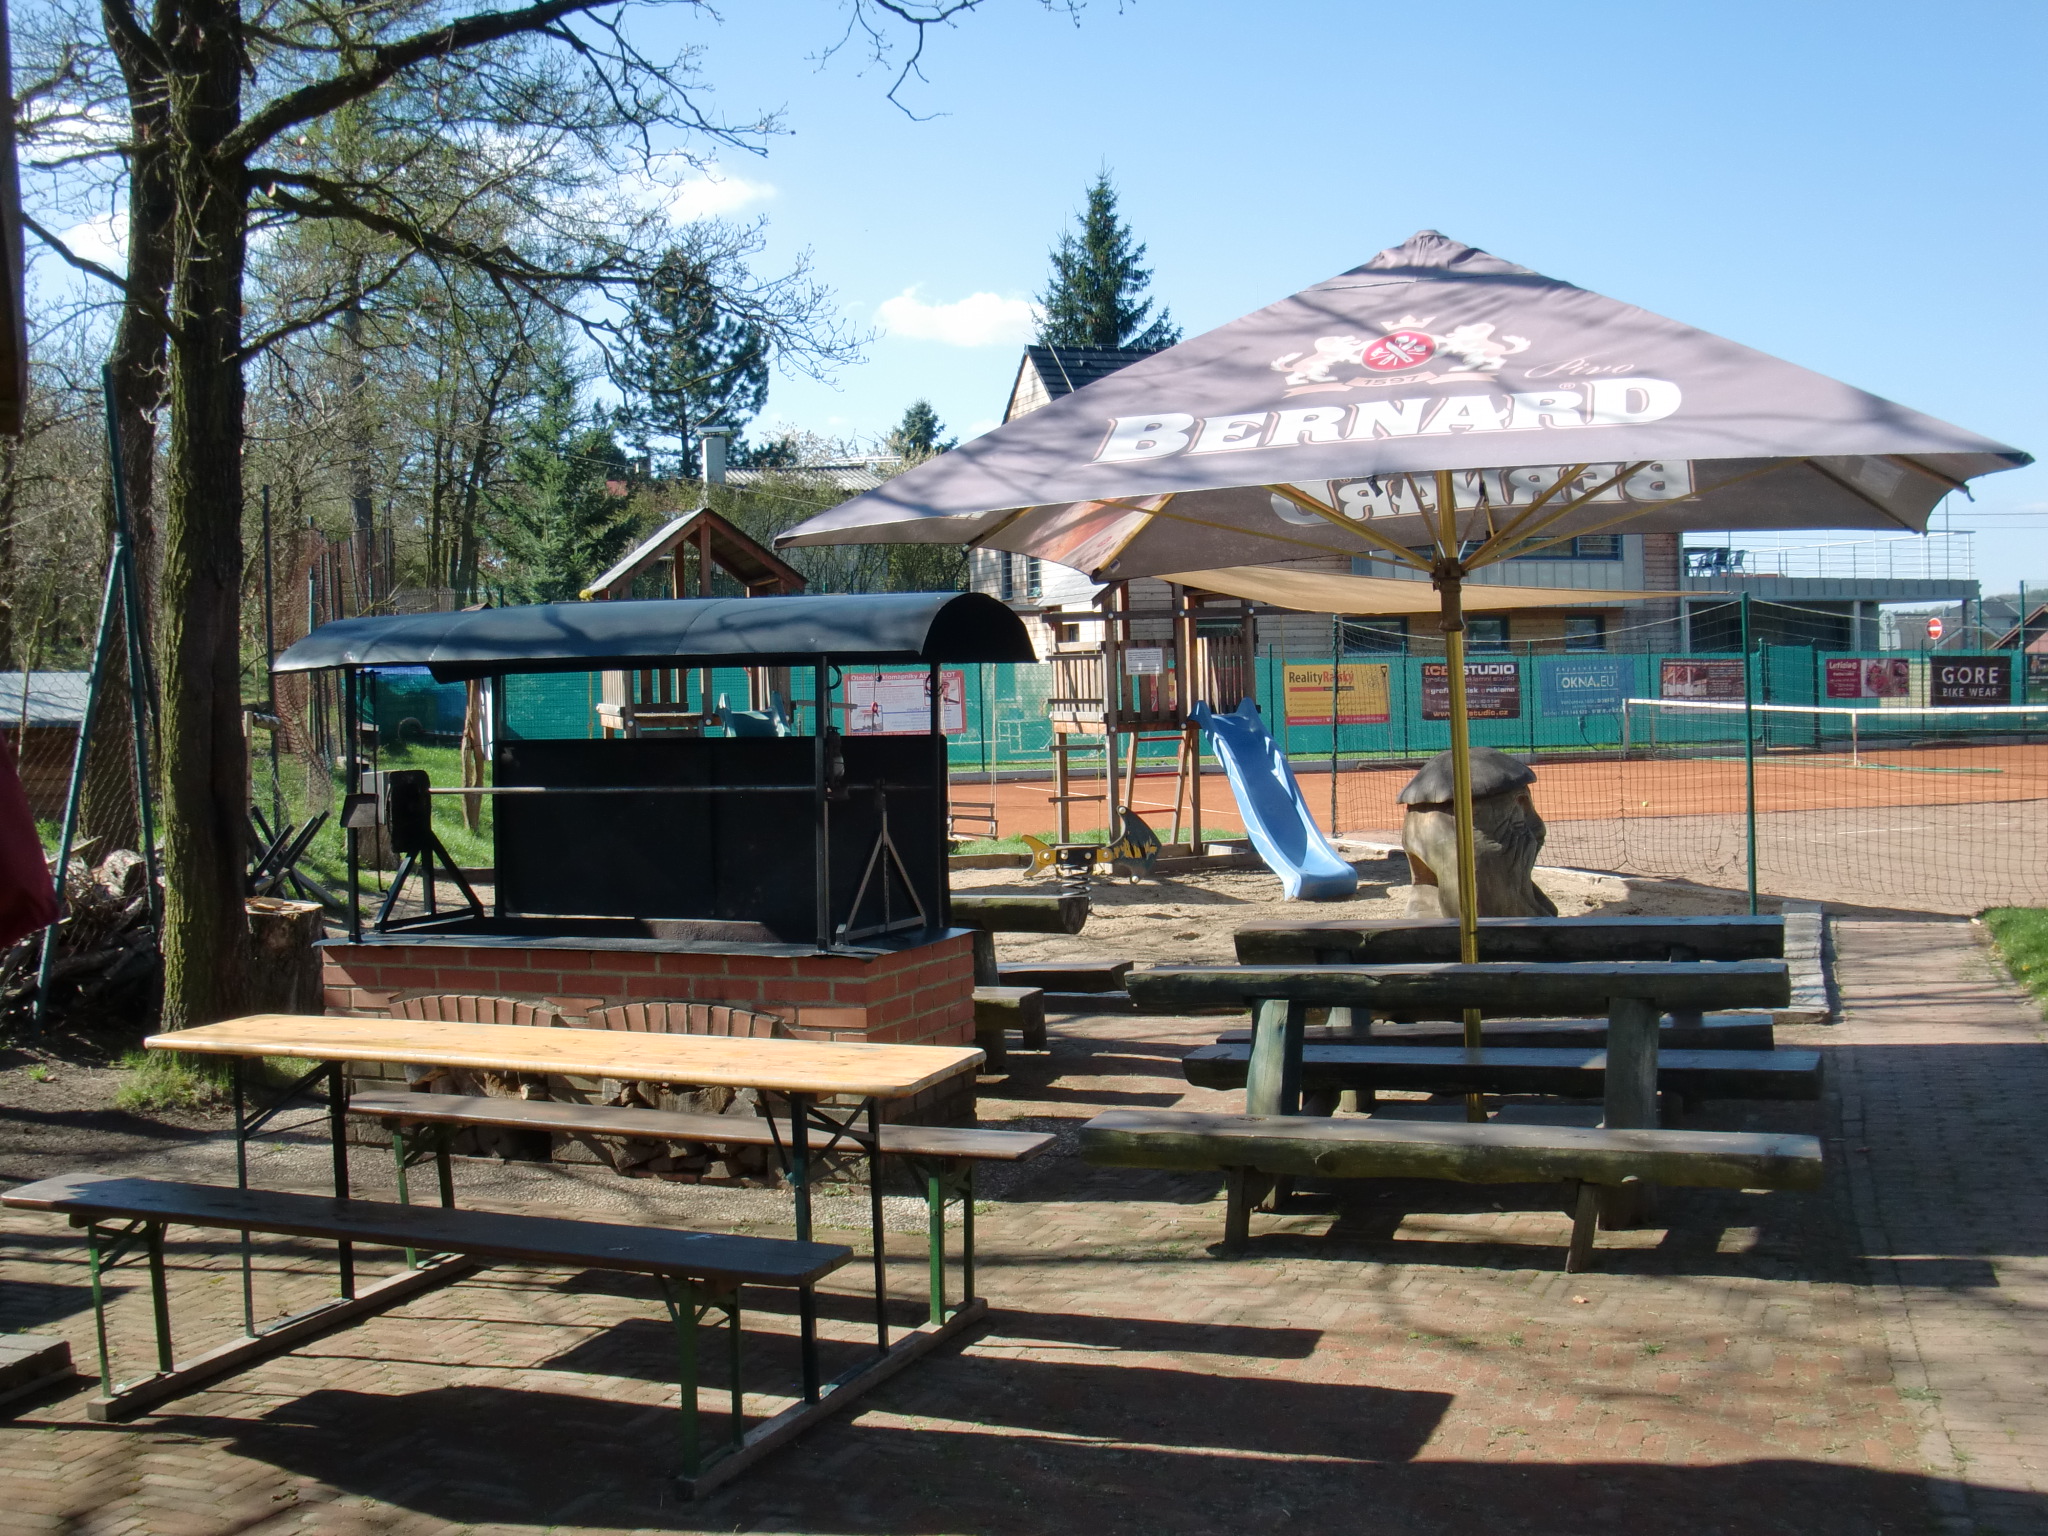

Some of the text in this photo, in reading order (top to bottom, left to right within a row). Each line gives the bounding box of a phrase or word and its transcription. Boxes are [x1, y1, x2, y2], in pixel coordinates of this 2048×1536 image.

[1524, 352, 1635, 378] Pivo
[1364, 375, 1419, 386] 1597
[1087, 377, 1682, 466] BERNARD
[1561, 675, 1615, 689] OKNA.EU
[1941, 666, 1999, 684] GORE
[1942, 687, 1965, 697] BIKE
